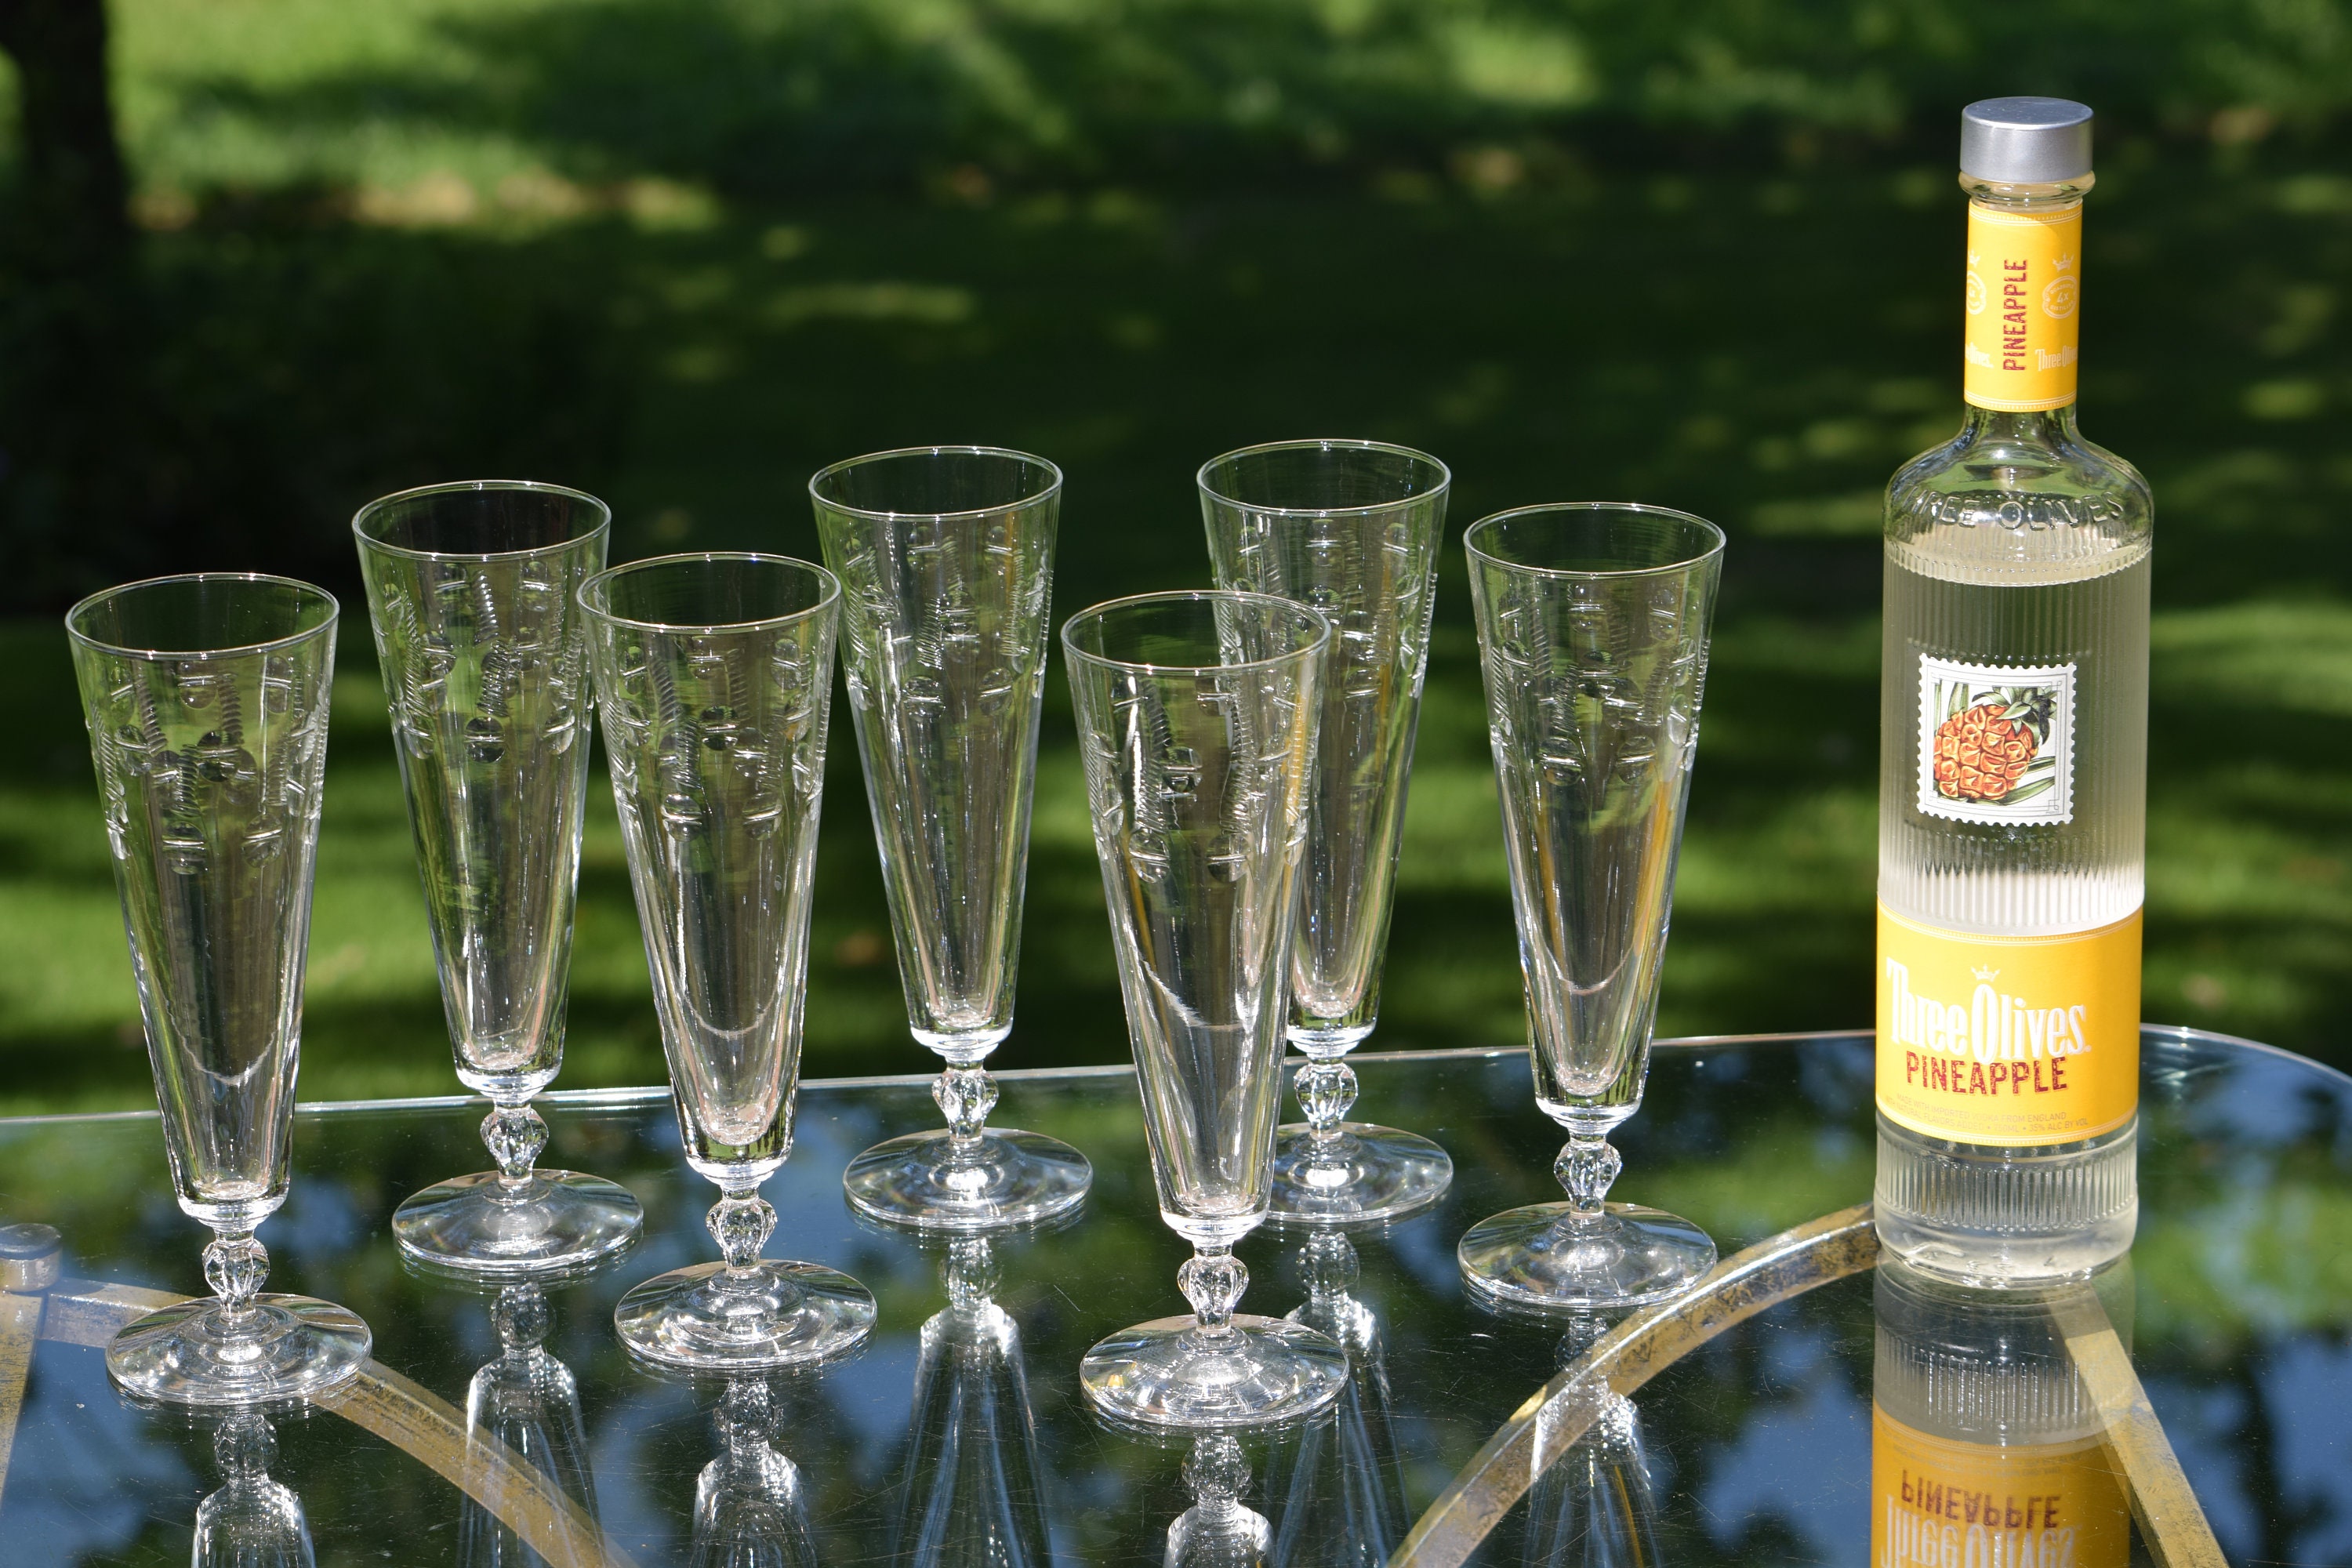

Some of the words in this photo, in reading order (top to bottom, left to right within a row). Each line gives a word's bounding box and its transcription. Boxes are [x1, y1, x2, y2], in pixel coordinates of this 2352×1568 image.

[2002, 259, 2027, 371] PINEAPPLE
[2034, 348, 2062, 372] Three
[1998, 491, 2124, 532] OLIVES
[1886, 956, 1968, 1056] Three
[1905, 1051, 2068, 1095] PINEAPPLE
[1913, 1100, 1930, 1110] WITH
[1931, 1105, 1970, 1120] IMPORTED
[2001, 1114, 2025, 1123] FROM
[2027, 1111, 2067, 1123] ENGLAND
[1923, 1112, 1955, 1127] FLAVORS
[1957, 1120, 1986, 1131] ADDED
[2048, 1121, 2063, 1131] ALC
[2064, 1120, 2074, 1129] BY
